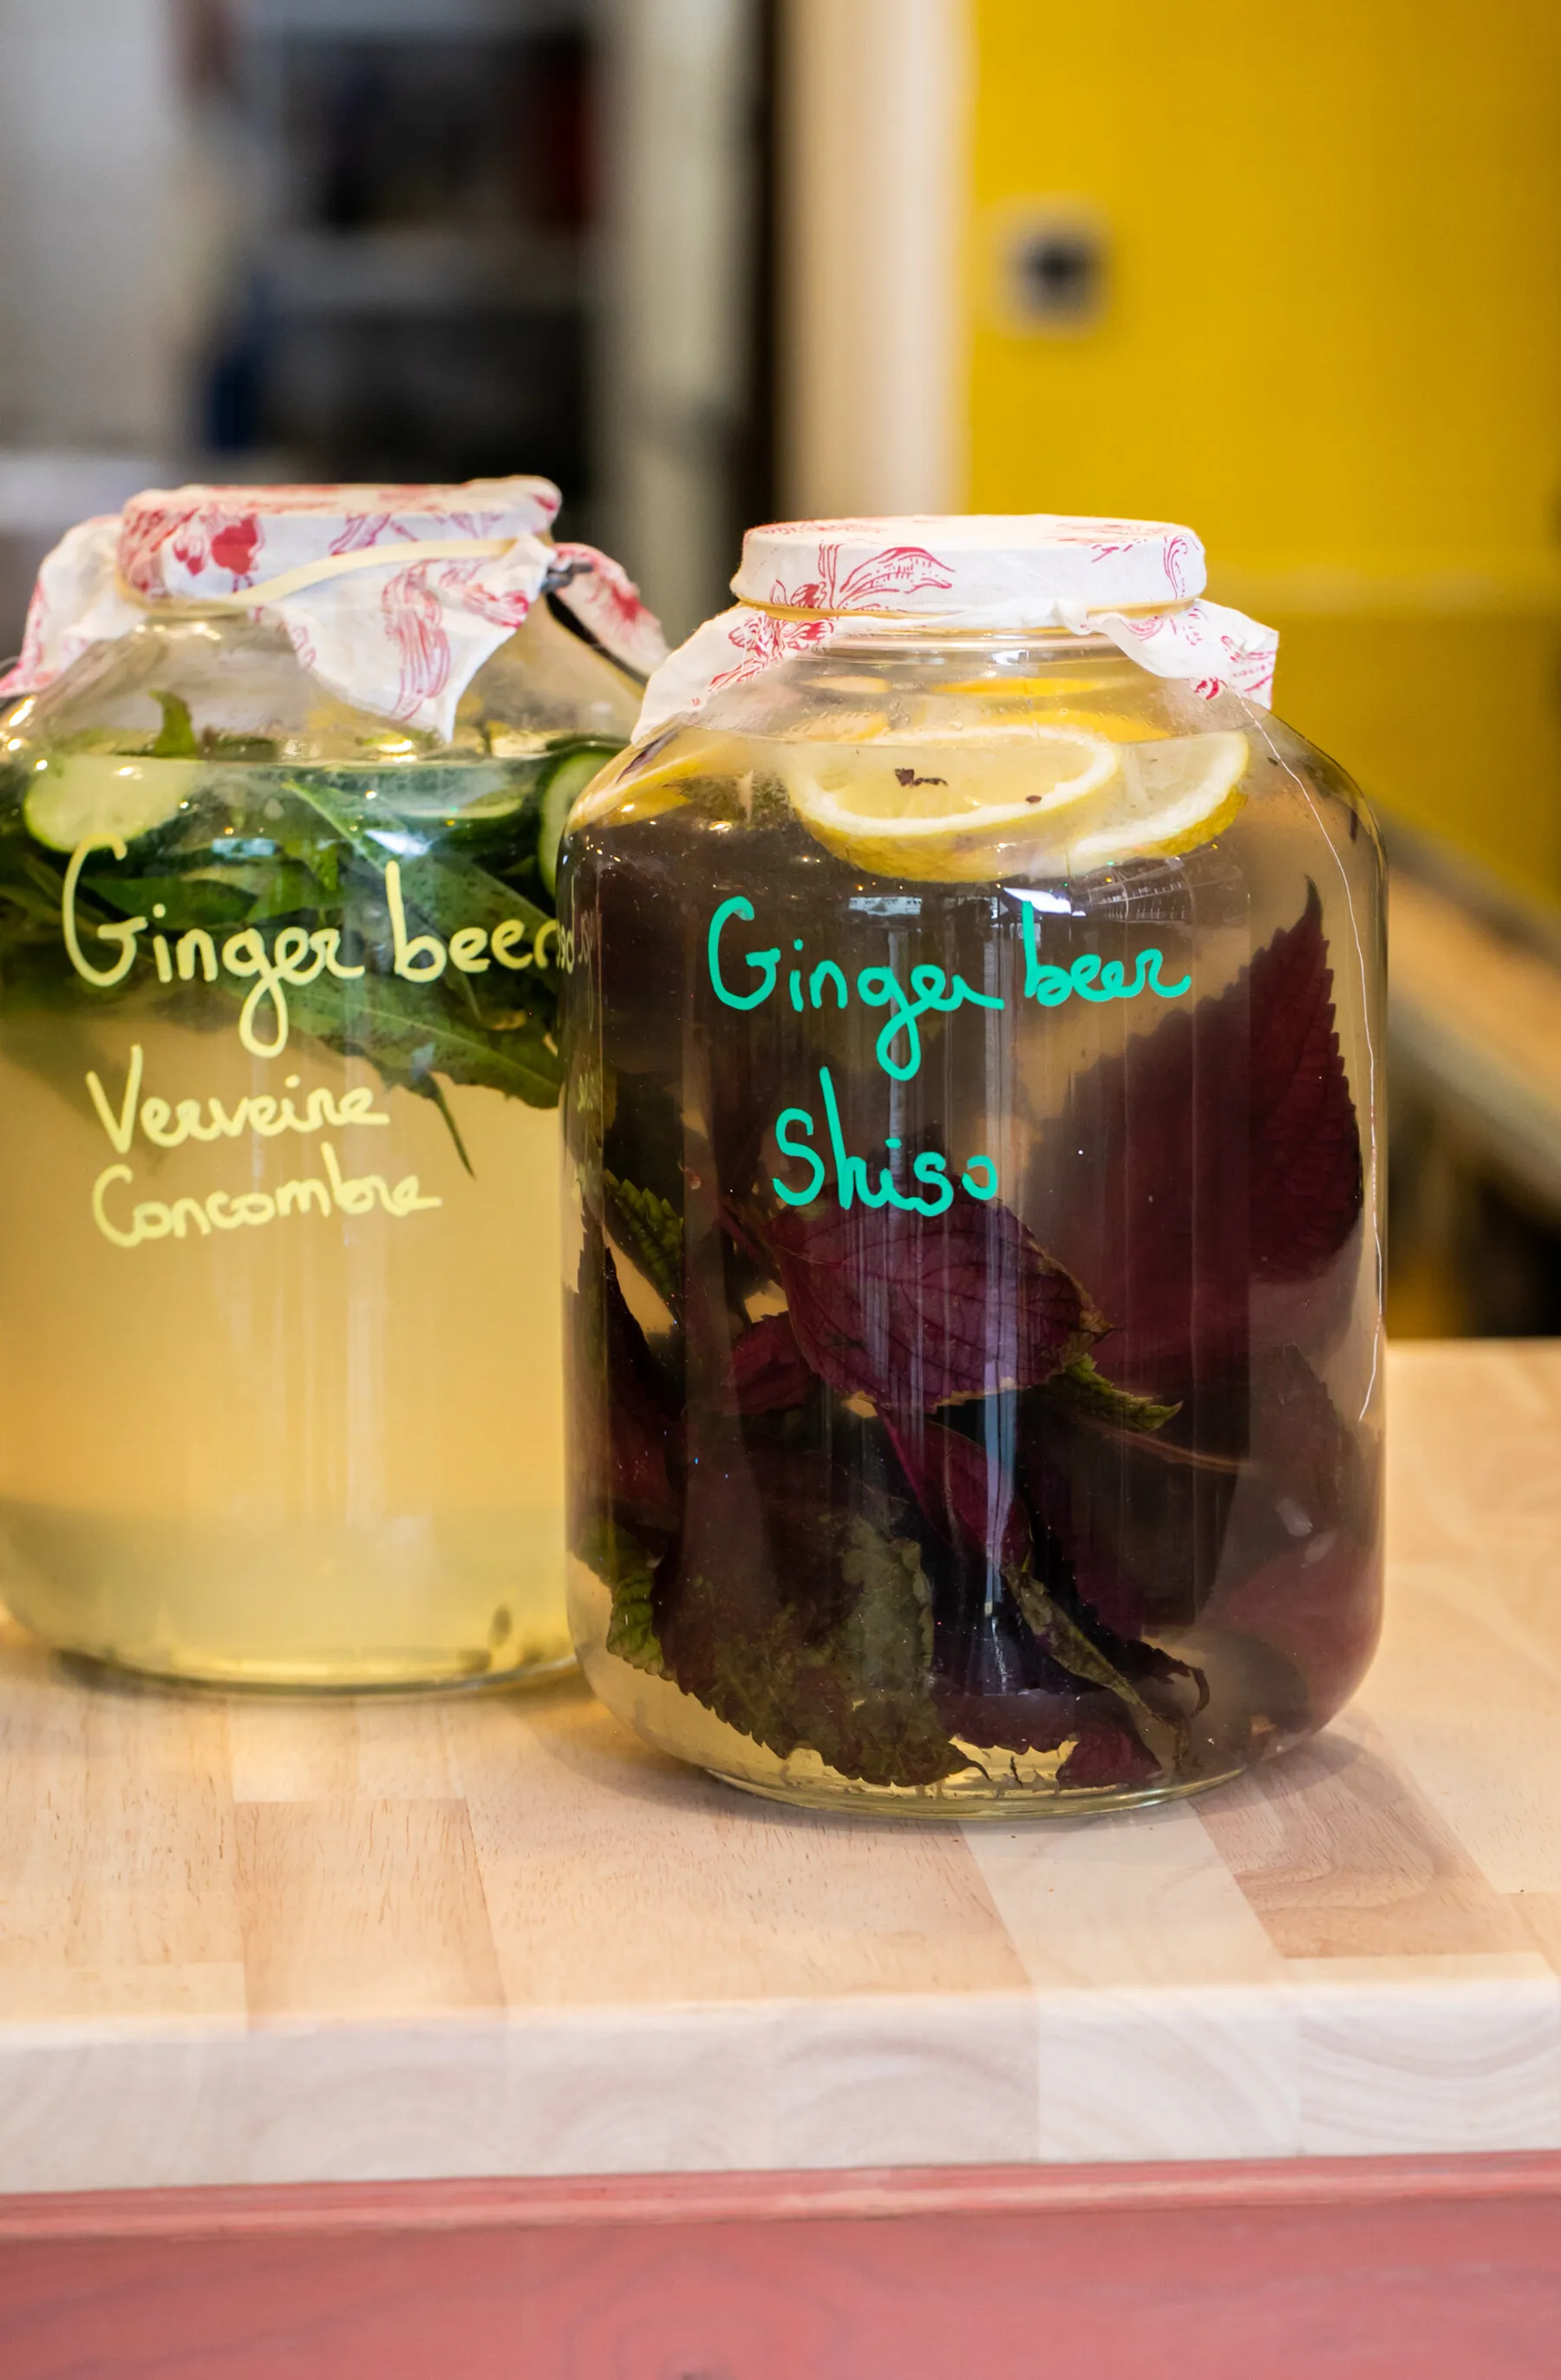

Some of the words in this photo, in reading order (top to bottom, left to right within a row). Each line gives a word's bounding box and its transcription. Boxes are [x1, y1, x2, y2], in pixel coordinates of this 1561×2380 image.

[62, 834, 365, 1058] Ginger
[385, 860, 559, 982] beer
[708, 895, 1005, 1081] Ginger
[1022, 900, 1192, 1007] beer
[86, 1043, 390, 1154] Verveine
[773, 1066, 998, 1217] Shiso
[92, 1141, 443, 1248] Concombre
